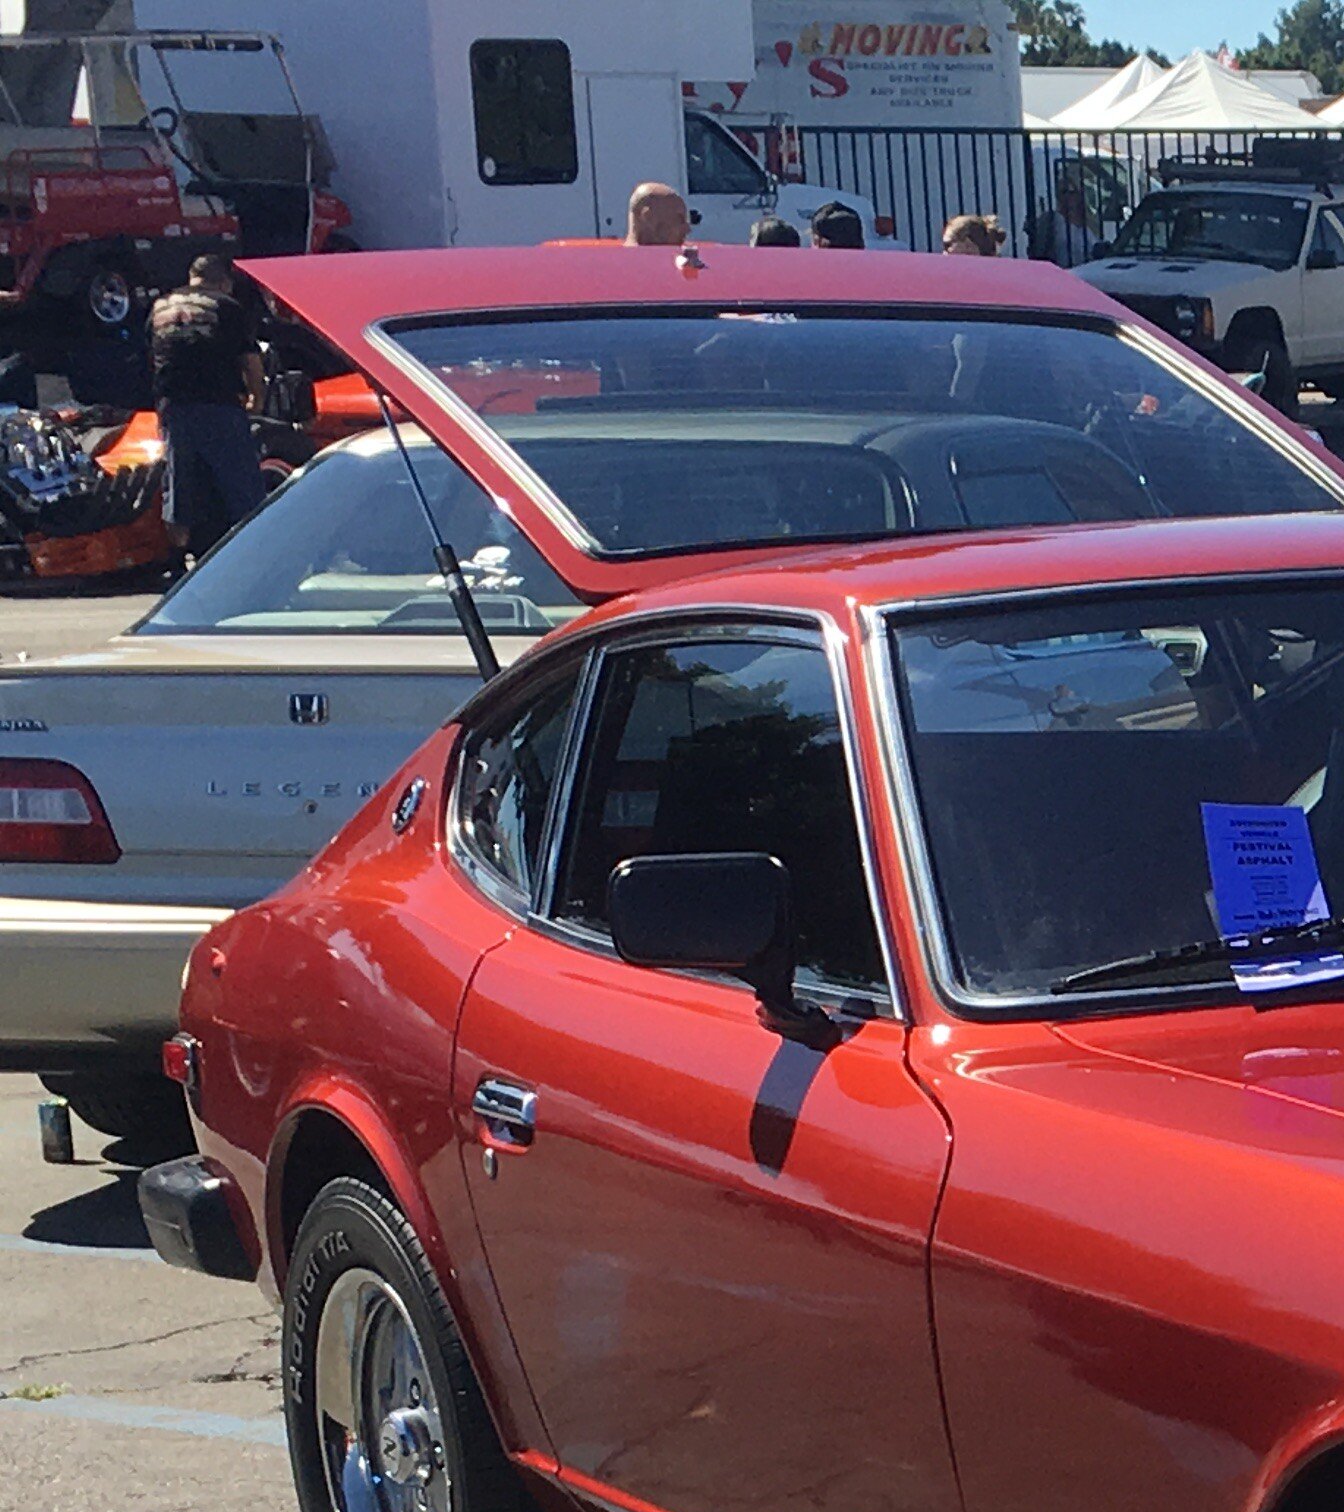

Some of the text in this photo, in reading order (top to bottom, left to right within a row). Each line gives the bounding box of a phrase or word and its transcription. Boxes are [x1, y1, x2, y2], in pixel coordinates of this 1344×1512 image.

[829, 23, 966, 56] MOVING
[207, 781, 379, 798] LEGEN
[1232, 842, 1293, 851] FESTIVAL
[1237, 855, 1294, 865] ASPHALT
